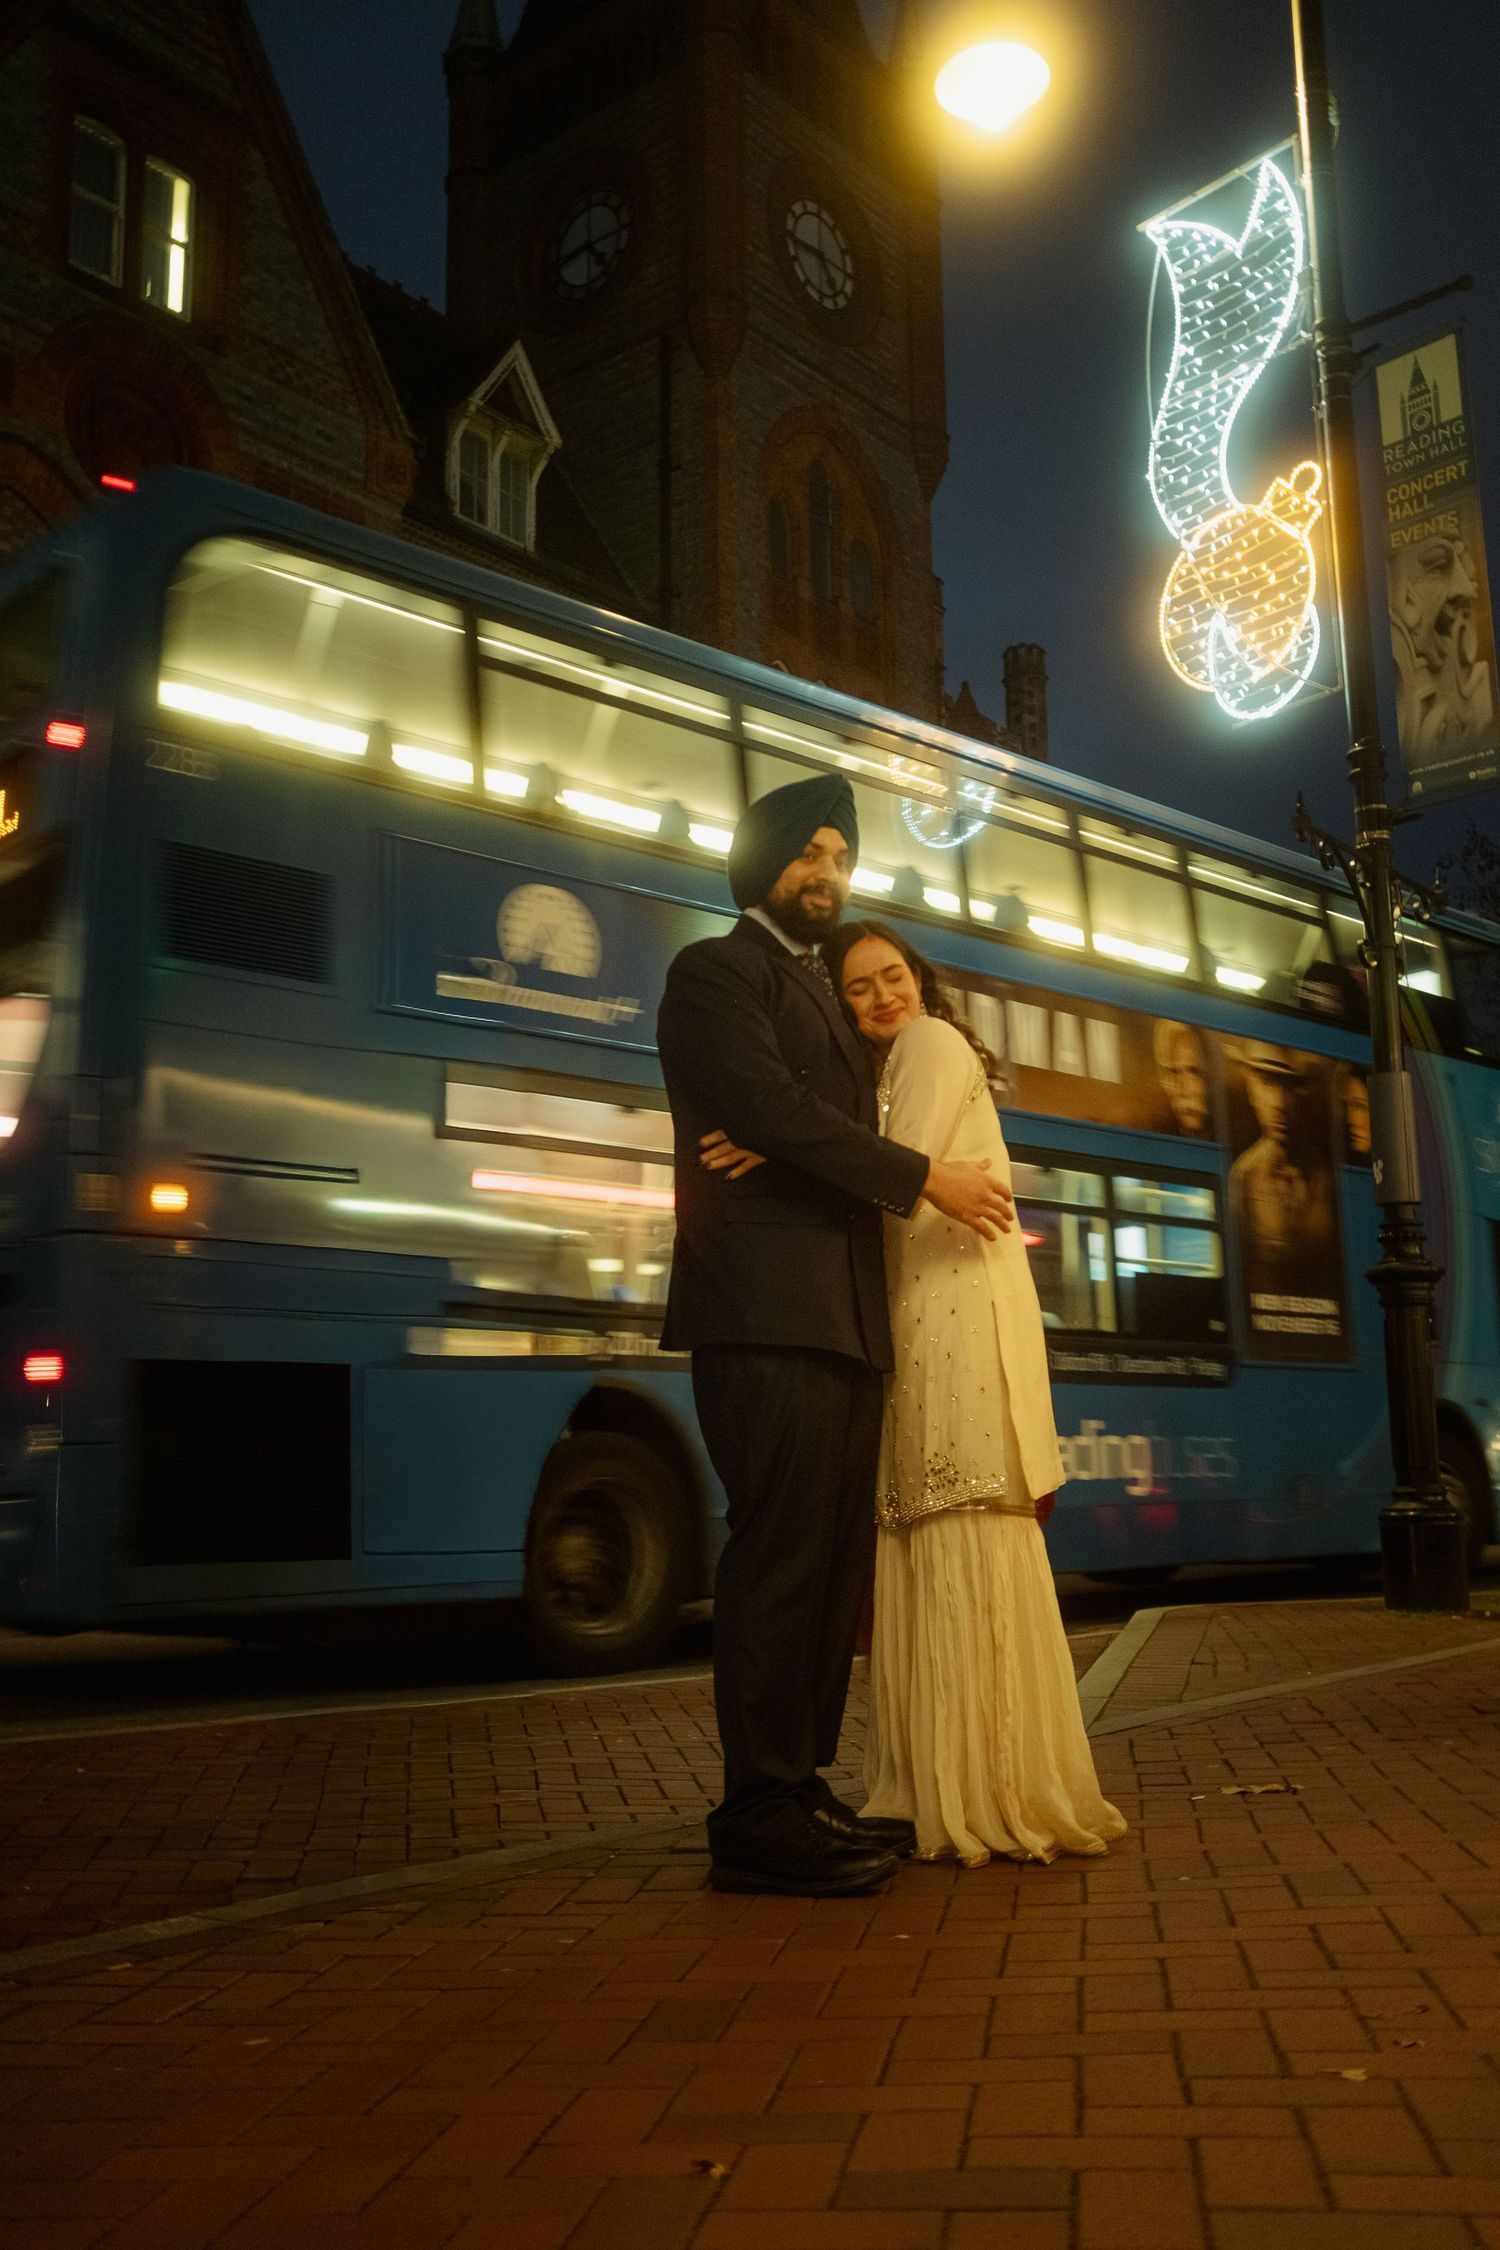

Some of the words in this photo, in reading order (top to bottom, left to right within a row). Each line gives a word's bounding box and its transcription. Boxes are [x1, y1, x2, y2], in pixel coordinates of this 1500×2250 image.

[1383, 419, 1466, 463] READING
[1385, 453, 1425, 475] TOWN
[1430, 436, 1467, 458] HALL
[1387, 460, 1468, 505] CONCERT
[1388, 494, 1434, 522] HALL
[1391, 510, 1458, 549] EVENTS
